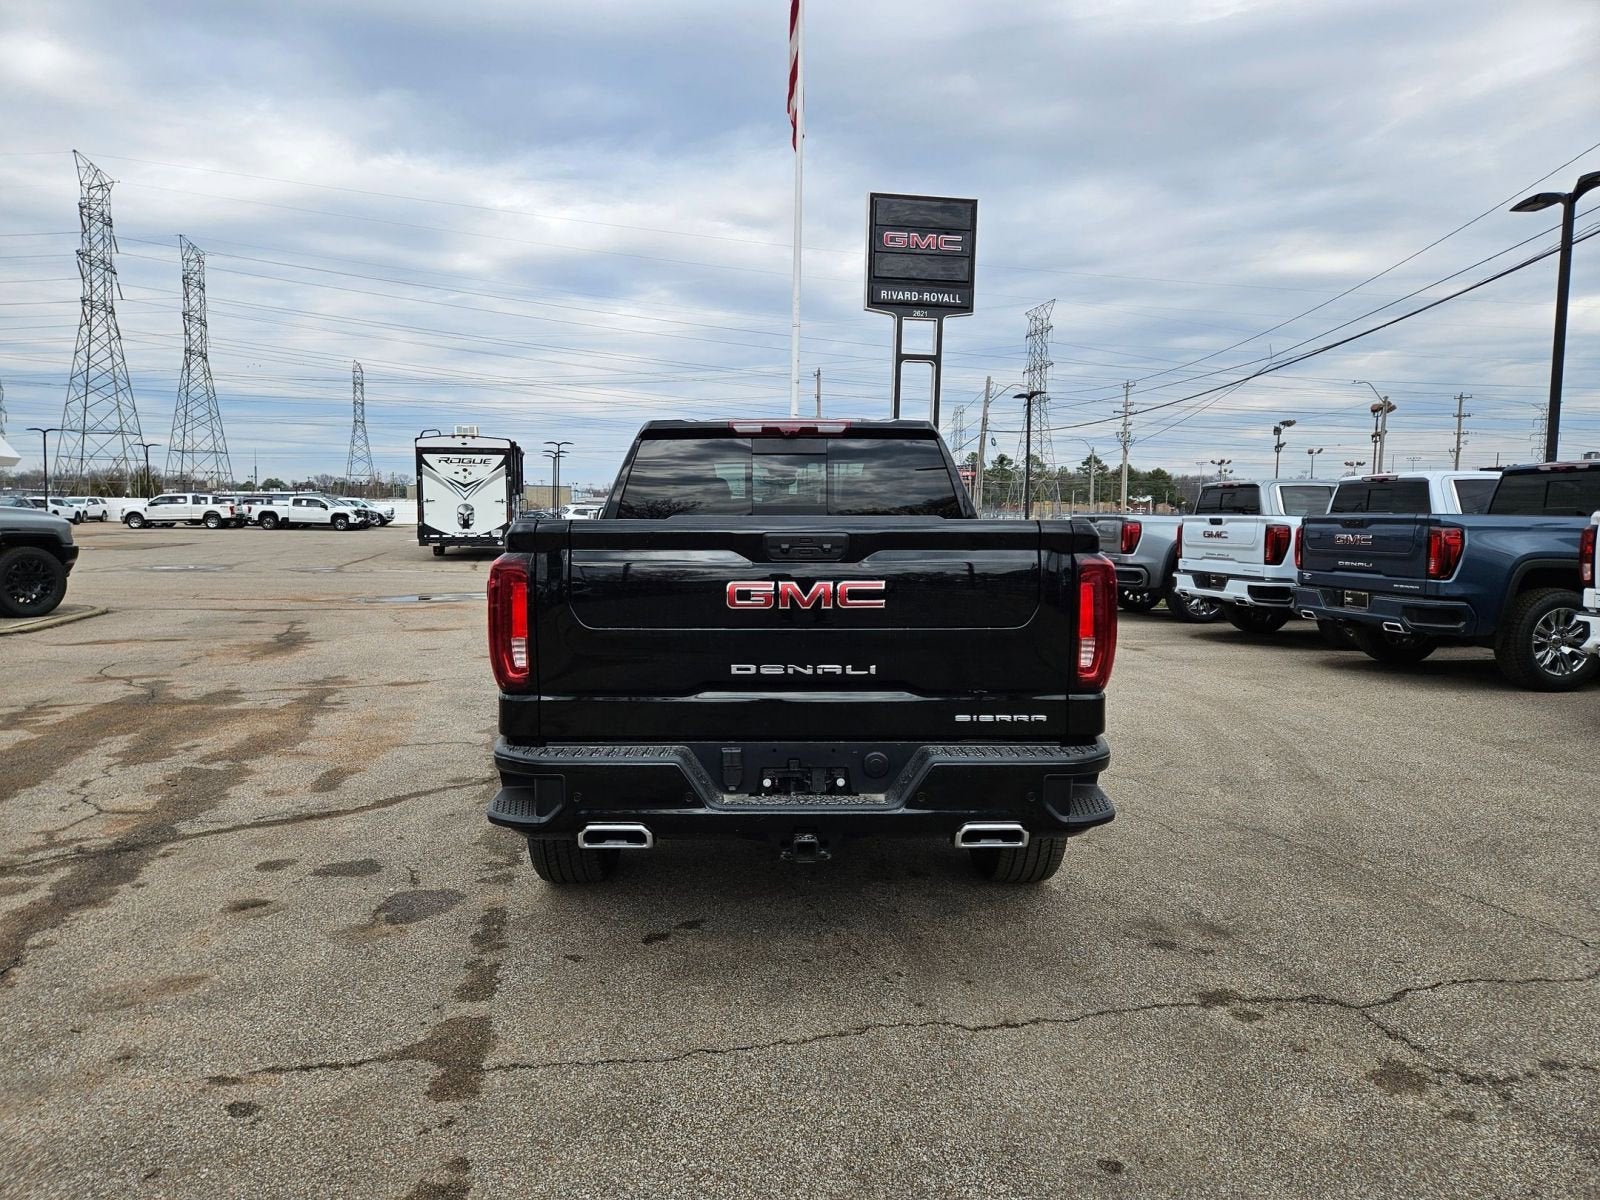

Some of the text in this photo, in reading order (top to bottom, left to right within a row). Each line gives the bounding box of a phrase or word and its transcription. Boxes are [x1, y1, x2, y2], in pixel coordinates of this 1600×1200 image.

[883, 231, 962, 251] GMC
[881, 290, 962, 303] RIVARD-ROYALL
[1202, 530, 1228, 539] GMC
[1334, 533, 1373, 546] GMC
[726, 580, 886, 610] GMC
[730, 664, 877, 675] DENALI
[954, 714, 1048, 722] SIERRA
